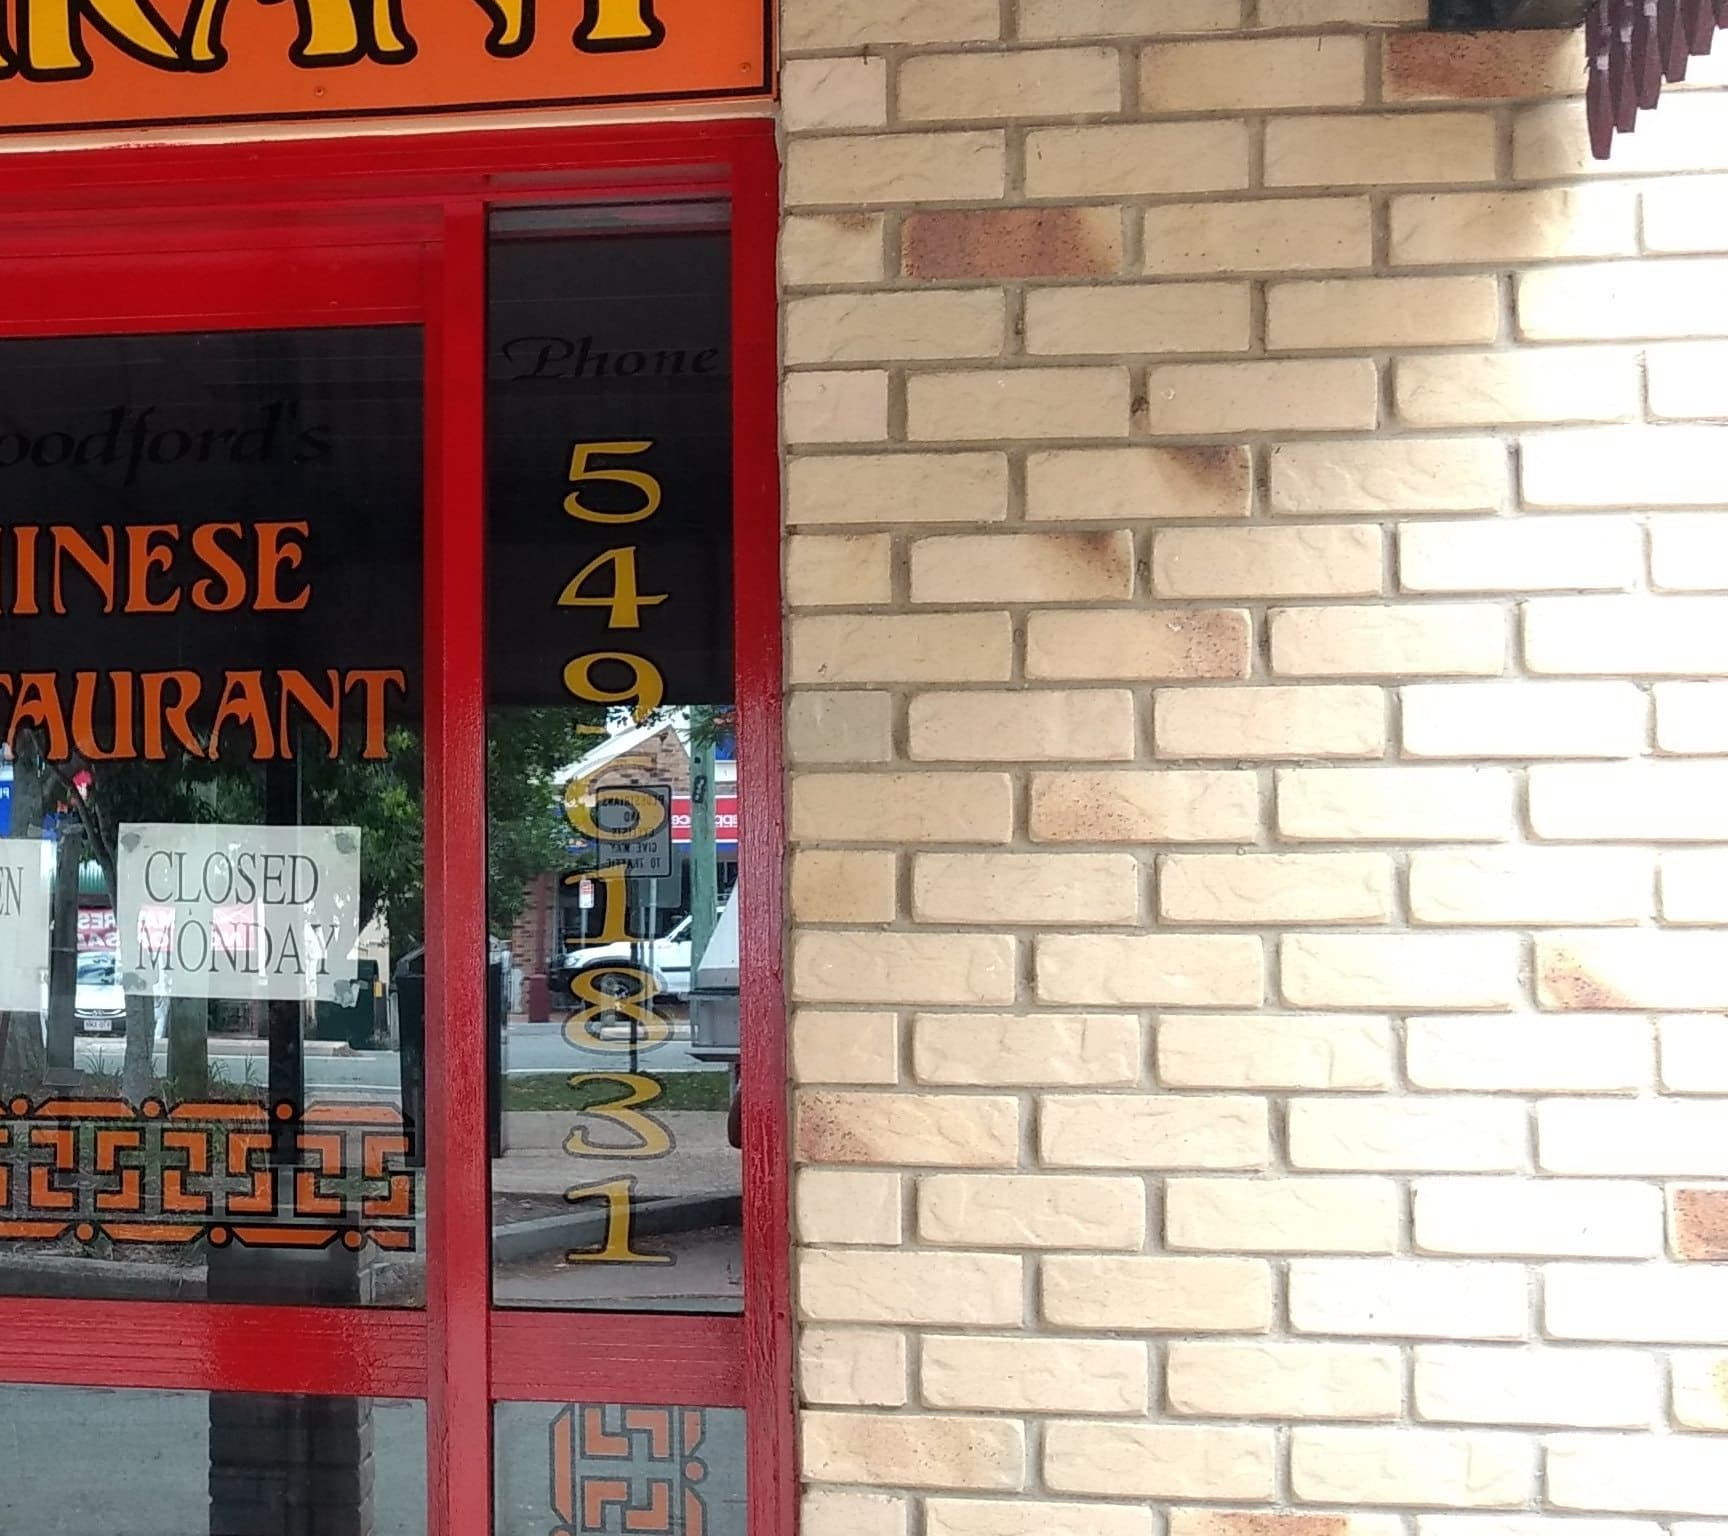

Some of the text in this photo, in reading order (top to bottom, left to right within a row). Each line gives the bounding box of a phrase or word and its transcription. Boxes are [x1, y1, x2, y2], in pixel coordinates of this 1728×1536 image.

[502, 336, 720, 382] Phone
[144, 851, 320, 906] CLOSED
[135, 919, 341, 976] MONDAY
